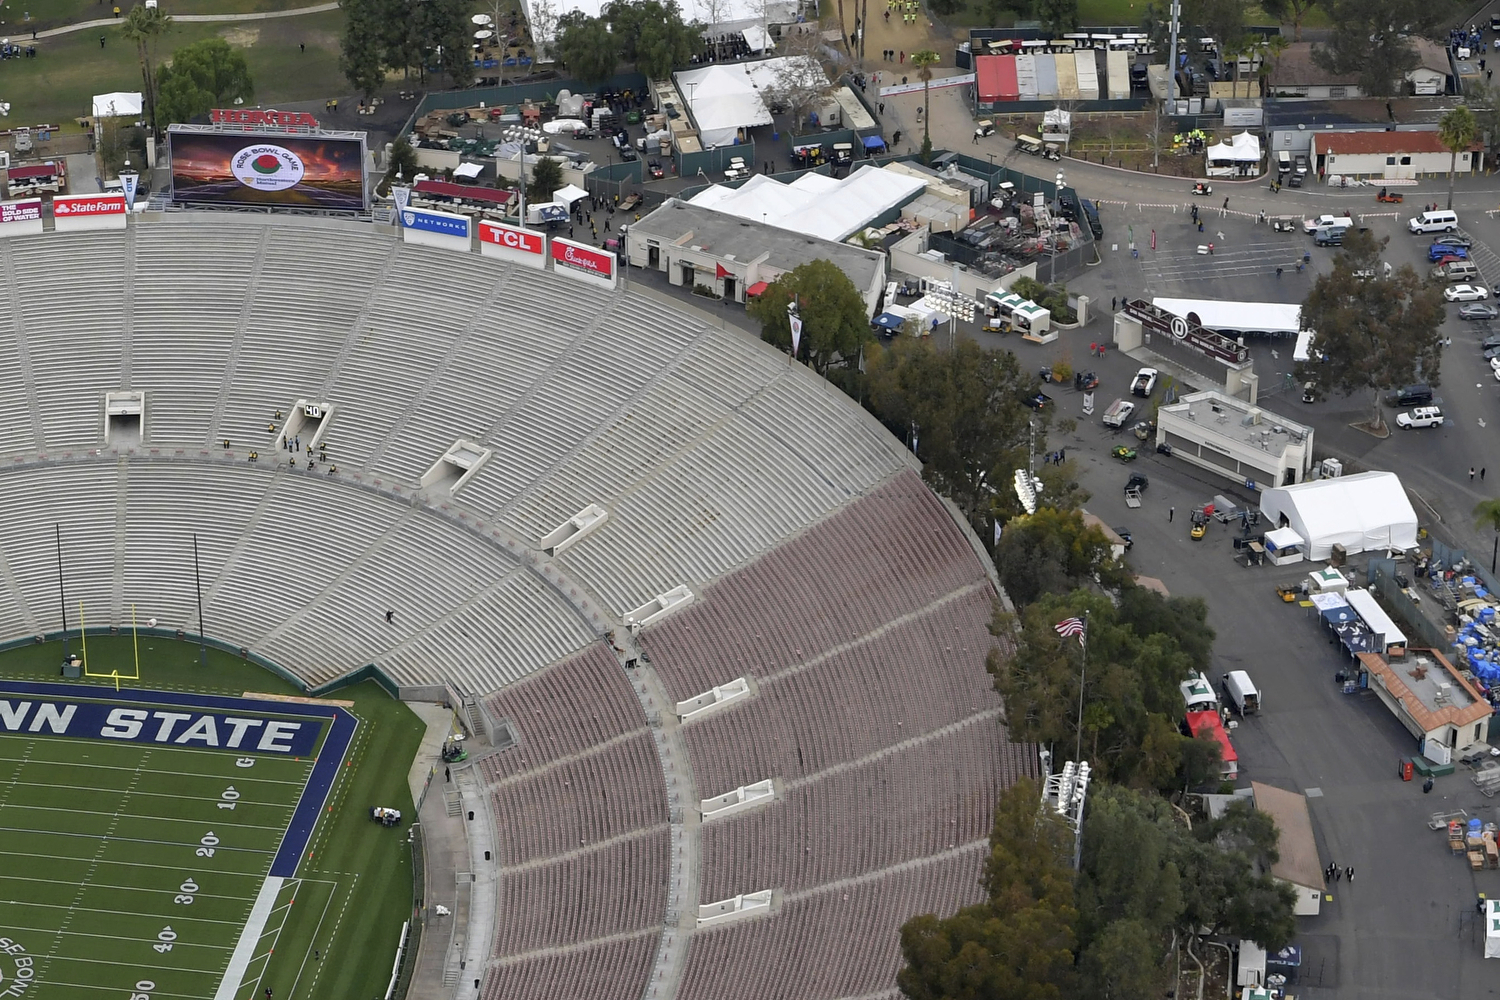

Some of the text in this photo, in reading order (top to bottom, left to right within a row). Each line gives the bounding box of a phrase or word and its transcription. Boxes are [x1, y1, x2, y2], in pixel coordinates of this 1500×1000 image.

[210, 109, 318, 126] HONDA
[236, 152, 251, 168] ROSE
[282, 152, 299, 170] GAME
[418, 218, 466, 230] NETWORKS
[490, 228, 531, 250] TCL
[1174, 321, 1184, 334] D
[306, 406, 319, 416] 40
[100, 707, 301, 753] STATE
[236, 757, 254, 767] G
[217, 786, 240, 810] 10
[195, 832, 219, 858] 20
[174, 878, 198, 905] 30
[153, 926, 178, 953] 40
